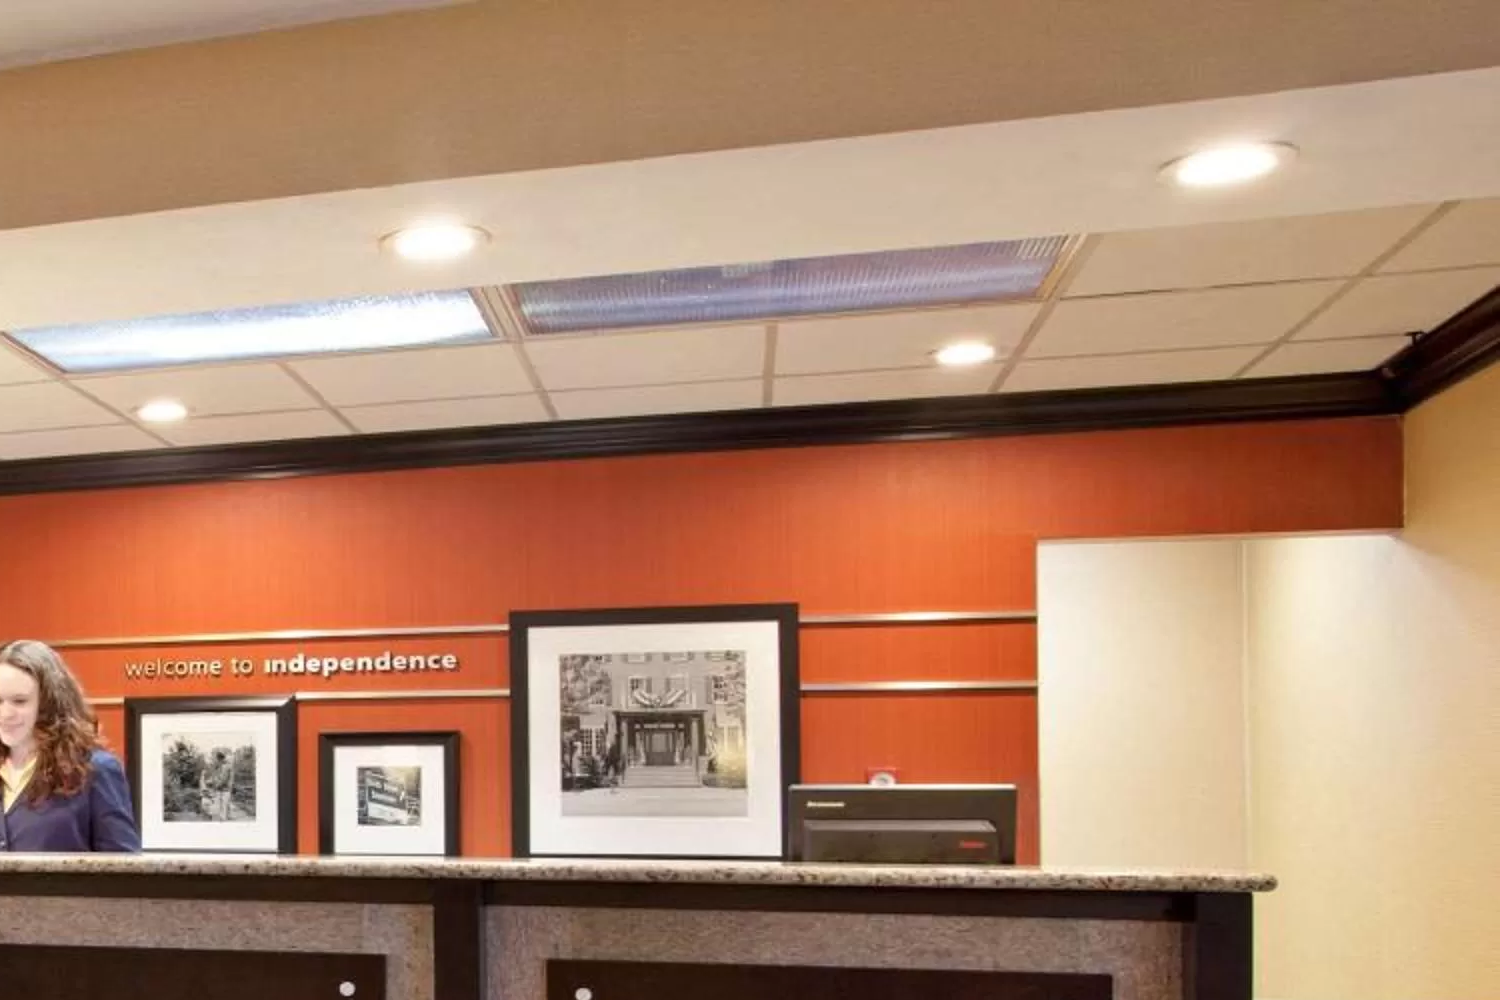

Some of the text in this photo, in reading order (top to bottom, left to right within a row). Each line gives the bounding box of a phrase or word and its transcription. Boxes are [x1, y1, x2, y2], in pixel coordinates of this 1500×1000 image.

[125, 650, 459, 678] welcome to independence
